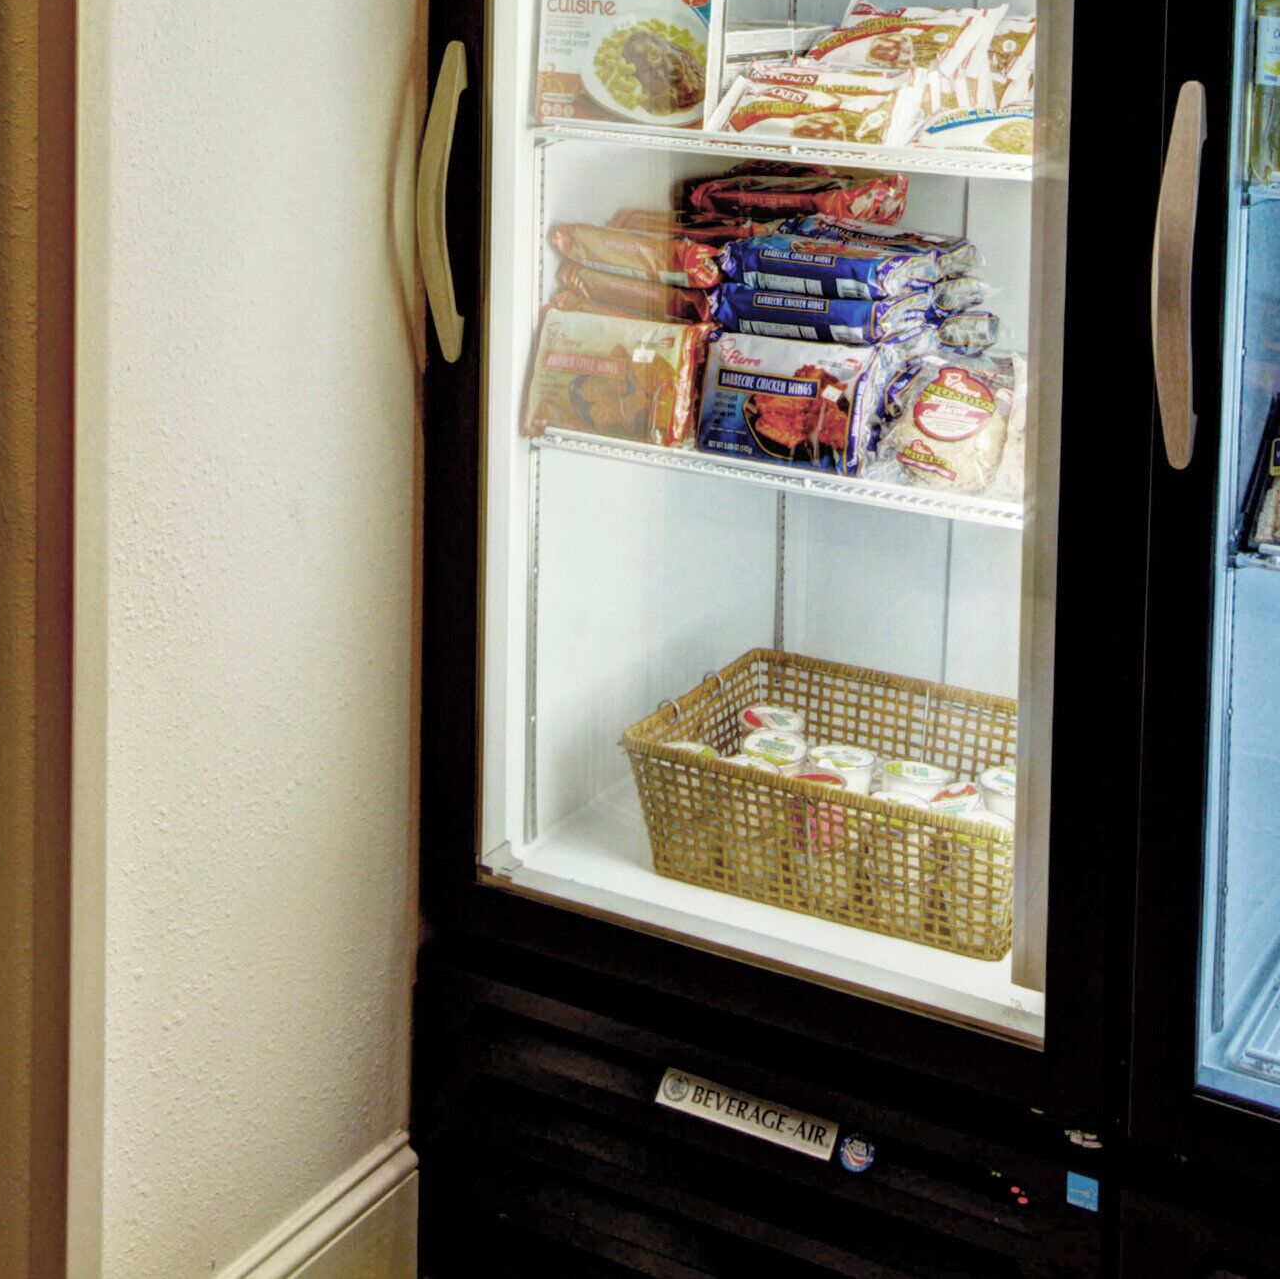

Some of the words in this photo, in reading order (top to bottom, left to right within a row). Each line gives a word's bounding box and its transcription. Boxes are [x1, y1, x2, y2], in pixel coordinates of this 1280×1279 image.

[772, 87, 806, 104] CKETS
[763, 248, 790, 260] BARBECUE
[791, 252, 814, 263] CHICKEN
[756, 295, 783, 307] BARBECUE
[784, 297, 807, 309] CHICKEN
[807, 299, 825, 310] WINGS
[727, 349, 763, 367] Pierre
[721, 371, 754, 390] BARBECUE
[756, 377, 787, 394] CHICKEN
[787, 381, 813, 396] WINGS
[927, 383, 990, 410] JUMBO
[691, 1085, 829, 1147] BEVERAGE-AIR
